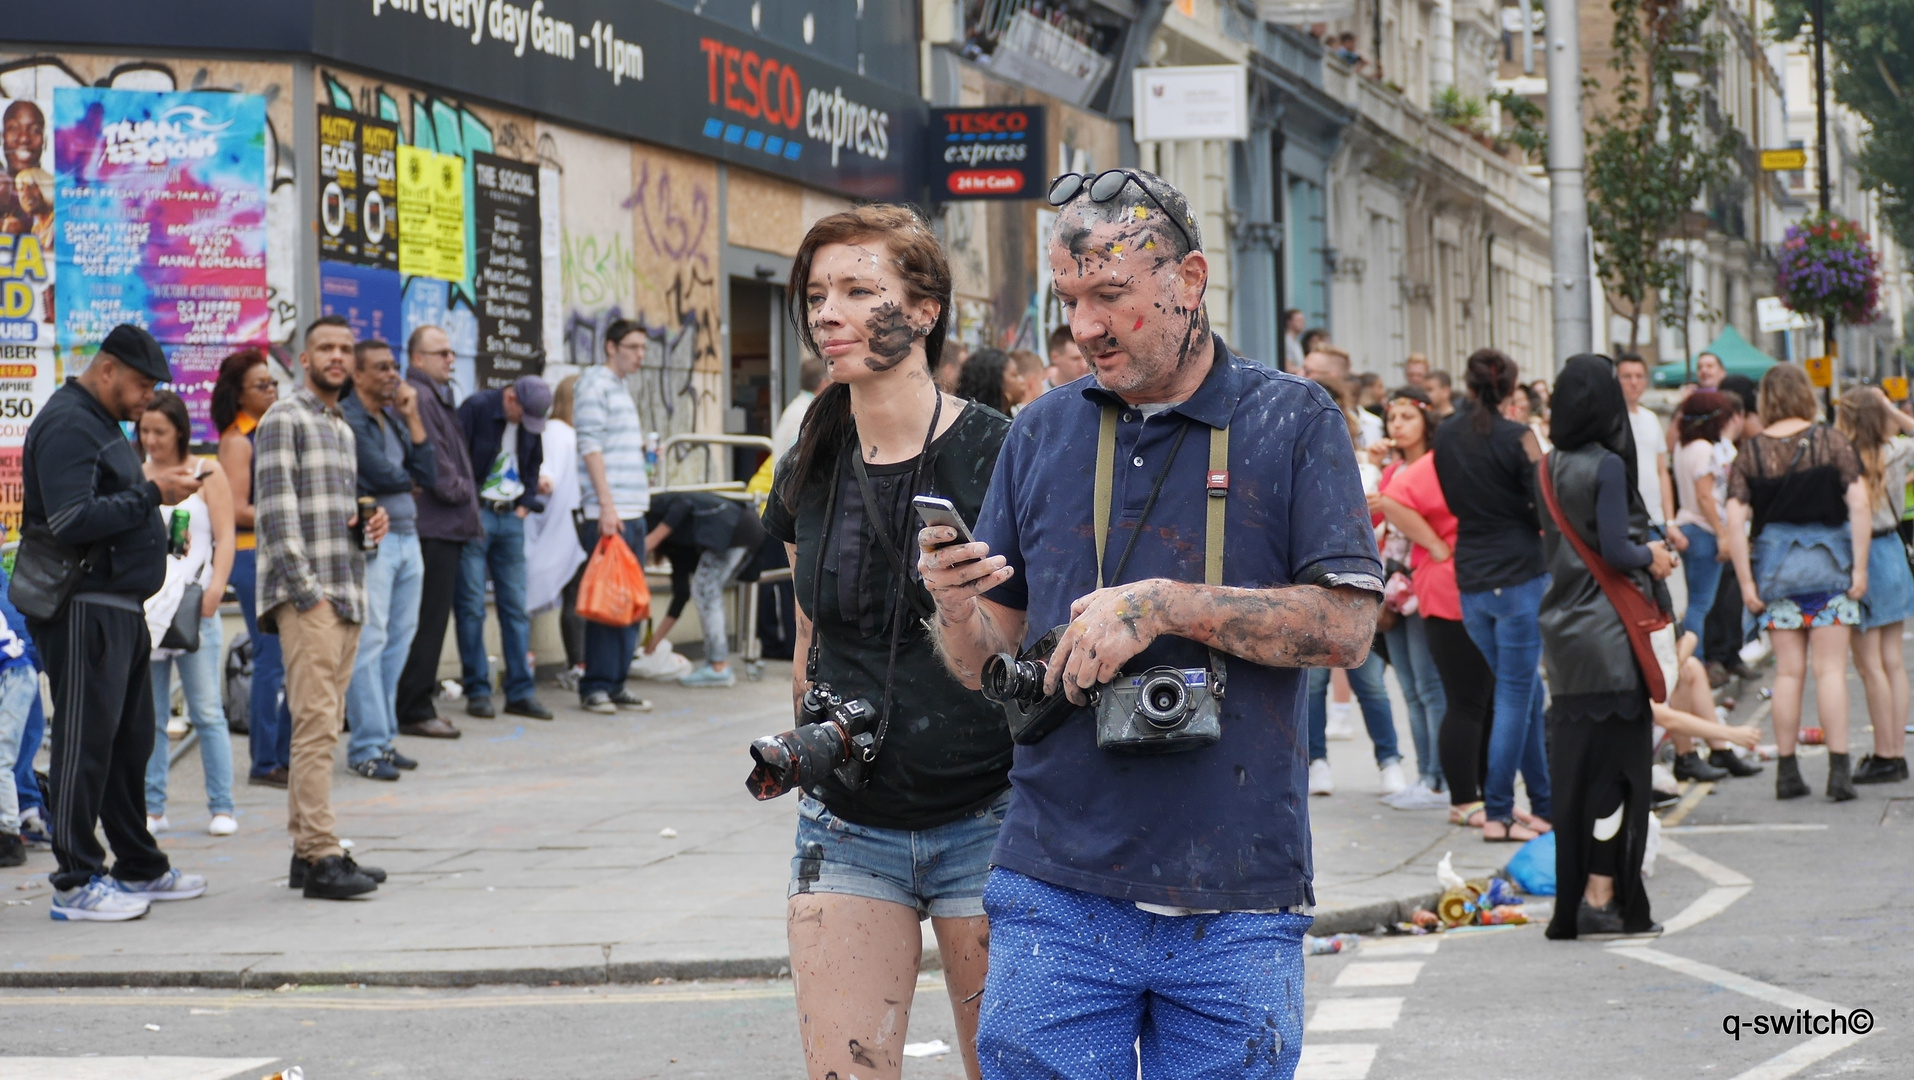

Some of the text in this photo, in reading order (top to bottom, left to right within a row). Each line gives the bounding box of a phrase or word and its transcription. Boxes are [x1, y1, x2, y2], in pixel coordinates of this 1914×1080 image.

[488, 0, 529, 58] day
[530, 0, 575, 61] 6am
[700, 36, 889, 169] TESCO express
[944, 112, 1028, 133] TESCO
[102, 117, 188, 145] TRIBAL
[99, 133, 219, 168] SESSIONS
[944, 143, 1028, 167] express
[476, 163, 536, 197] THE SOCIAL
[957, 176, 1016, 190] 24 hr Cash
[61, 186, 96, 199] EVERY
[99, 187, 140, 200] FRIDAY
[201, 190, 216, 202] AT
[103, 222, 151, 234] ATKINS
[73, 254, 142, 265] BLUE HOUR
[158, 255, 196, 267] MANU
[161, 284, 188, 297] OCTOBER
[90, 299, 122, 310] NOIR
[177, 301, 241, 313] DJ PIERRE
[69, 310, 144, 321] PHIL WEEKS
[178, 312, 240, 324] DARK SKY
[65, 320, 89, 331] THE
[835, 710, 848, 725] SONY
